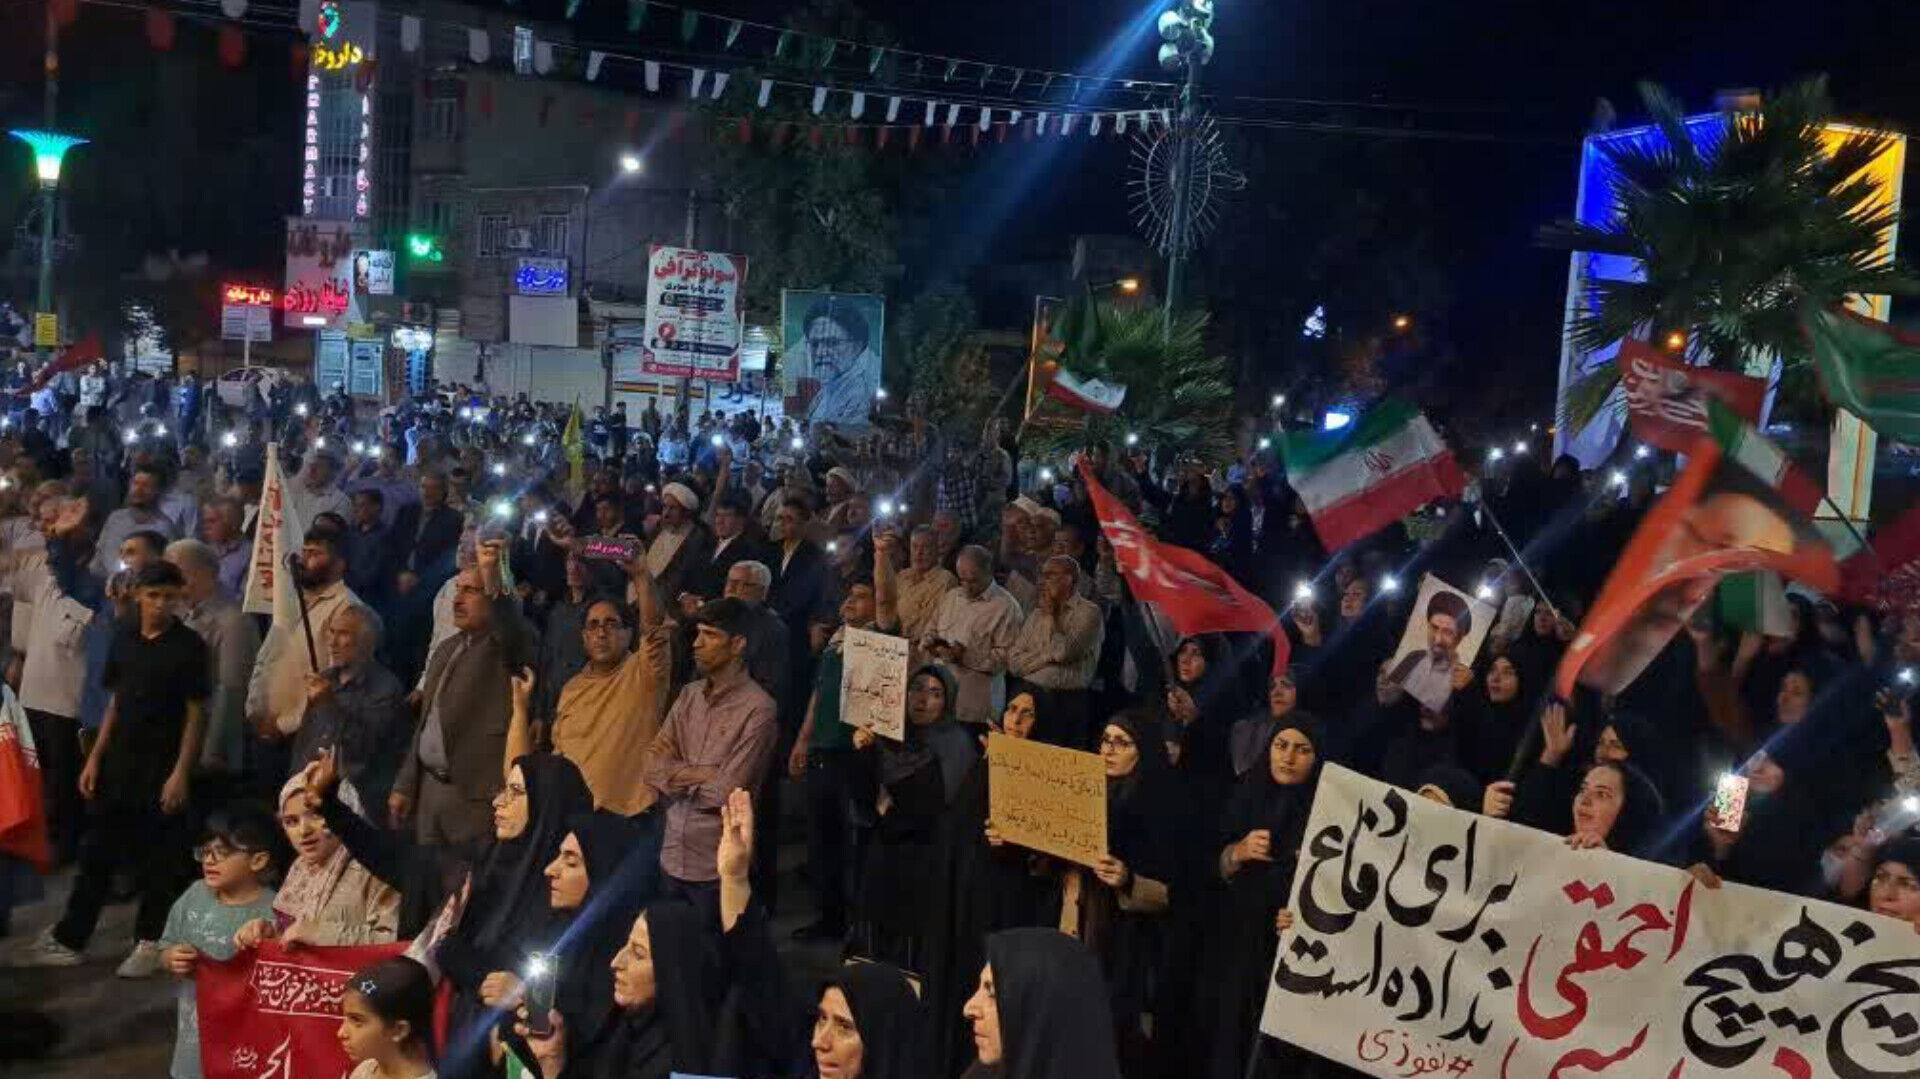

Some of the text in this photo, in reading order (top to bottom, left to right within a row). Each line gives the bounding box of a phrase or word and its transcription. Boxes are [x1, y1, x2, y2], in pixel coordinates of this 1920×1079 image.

[303, 75, 319, 214] PHARMACY
[226, 286, 271, 304] داروخانه
[1298, 787, 1408, 935] دفاع
[1384, 819, 1518, 954] برای
[1274, 920, 1513, 1045] نداده است
[1516, 878, 1696, 1040] احمقی
[1682, 905, 1844, 1068] هیچ
[1357, 1029, 1474, 1078] #نفوذی
